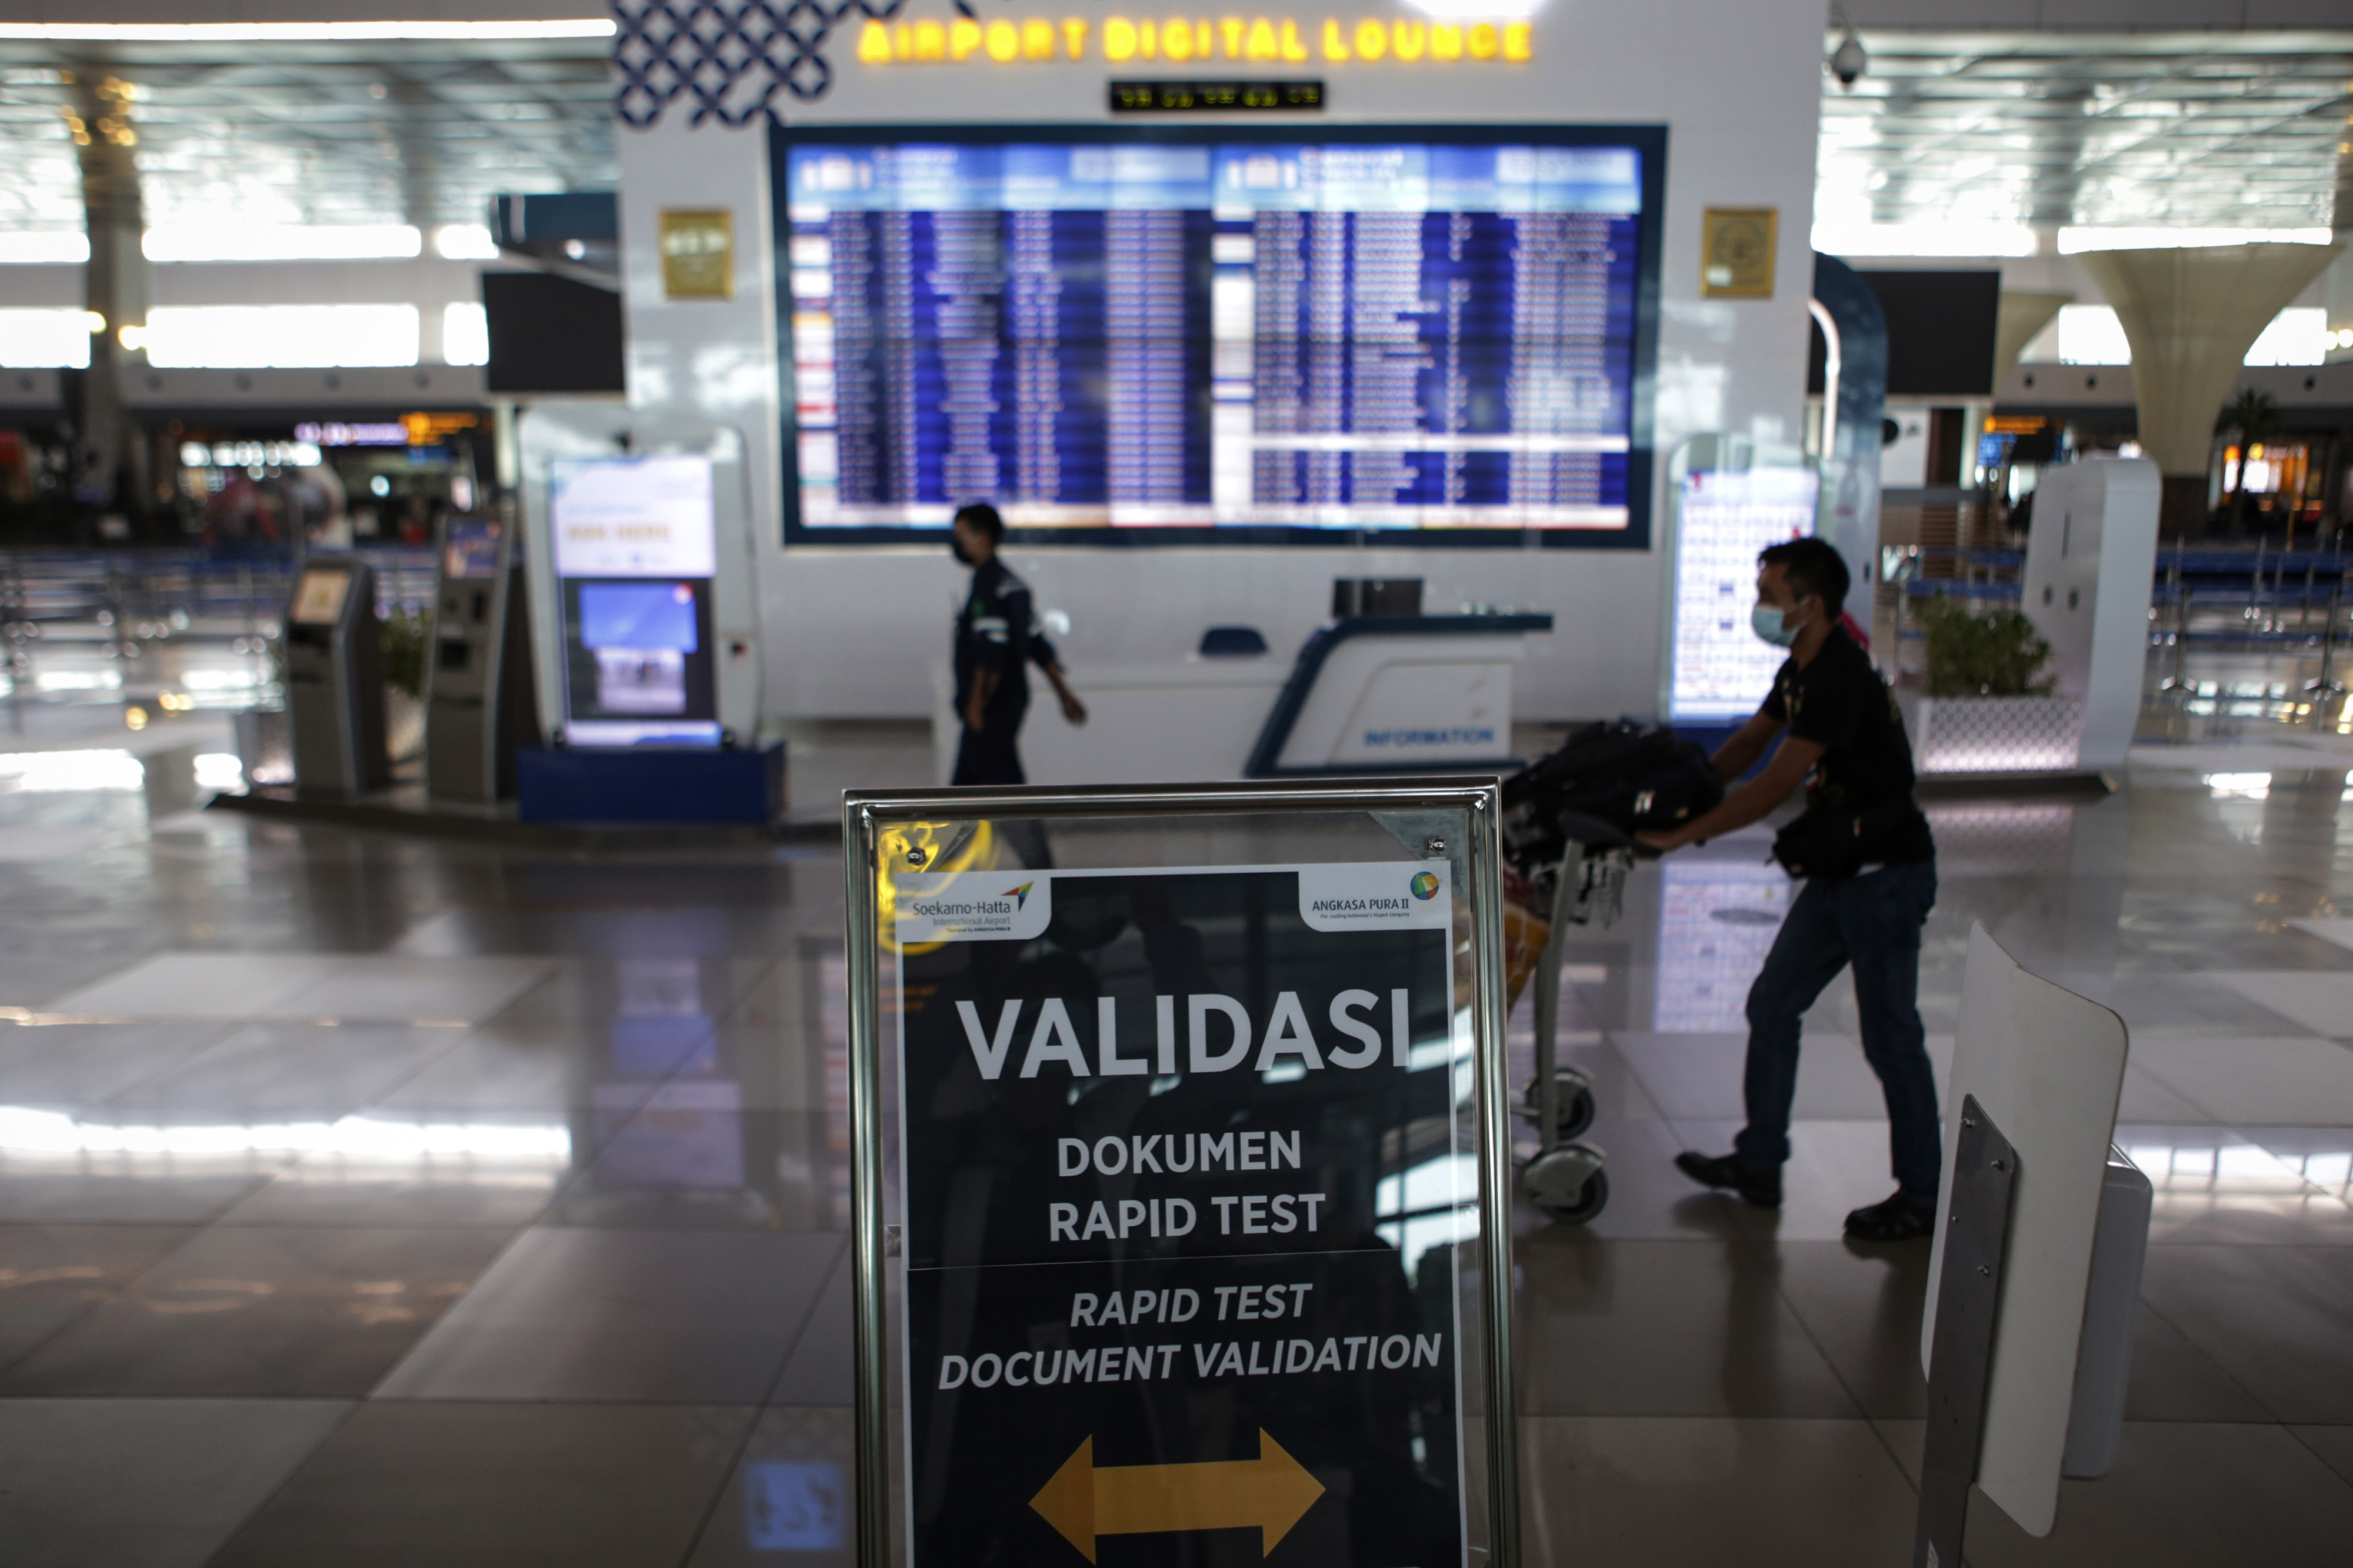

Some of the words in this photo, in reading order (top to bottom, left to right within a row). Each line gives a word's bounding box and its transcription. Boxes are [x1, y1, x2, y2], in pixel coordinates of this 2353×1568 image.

[858, 19, 1088, 62] AIRPORT
[1103, 19, 1308, 62] DIGITAL
[1322, 20, 1532, 62] LOUNGE
[1364, 727, 1494, 746] INFORMATION
[913, 901, 1011, 915] Soekarno-Hatta
[933, 916, 982, 926] International
[984, 916, 1011, 926] Airport
[1312, 899, 1367, 911] ANGKASA
[1369, 899, 1399, 909] PURA
[1401, 898, 1409, 909] II
[955, 988, 1409, 1080] VALIDASI
[1058, 1130, 1301, 1177] DOKUMEN
[1050, 1198, 1197, 1242] RAPID
[1211, 1193, 1326, 1235] TEST
[1070, 1289, 1199, 1327] RAPID
[1214, 1283, 1313, 1320] TEST
[939, 1345, 1181, 1389] DOCUMENT
[1195, 1333, 1441, 1377] VALIDATION
